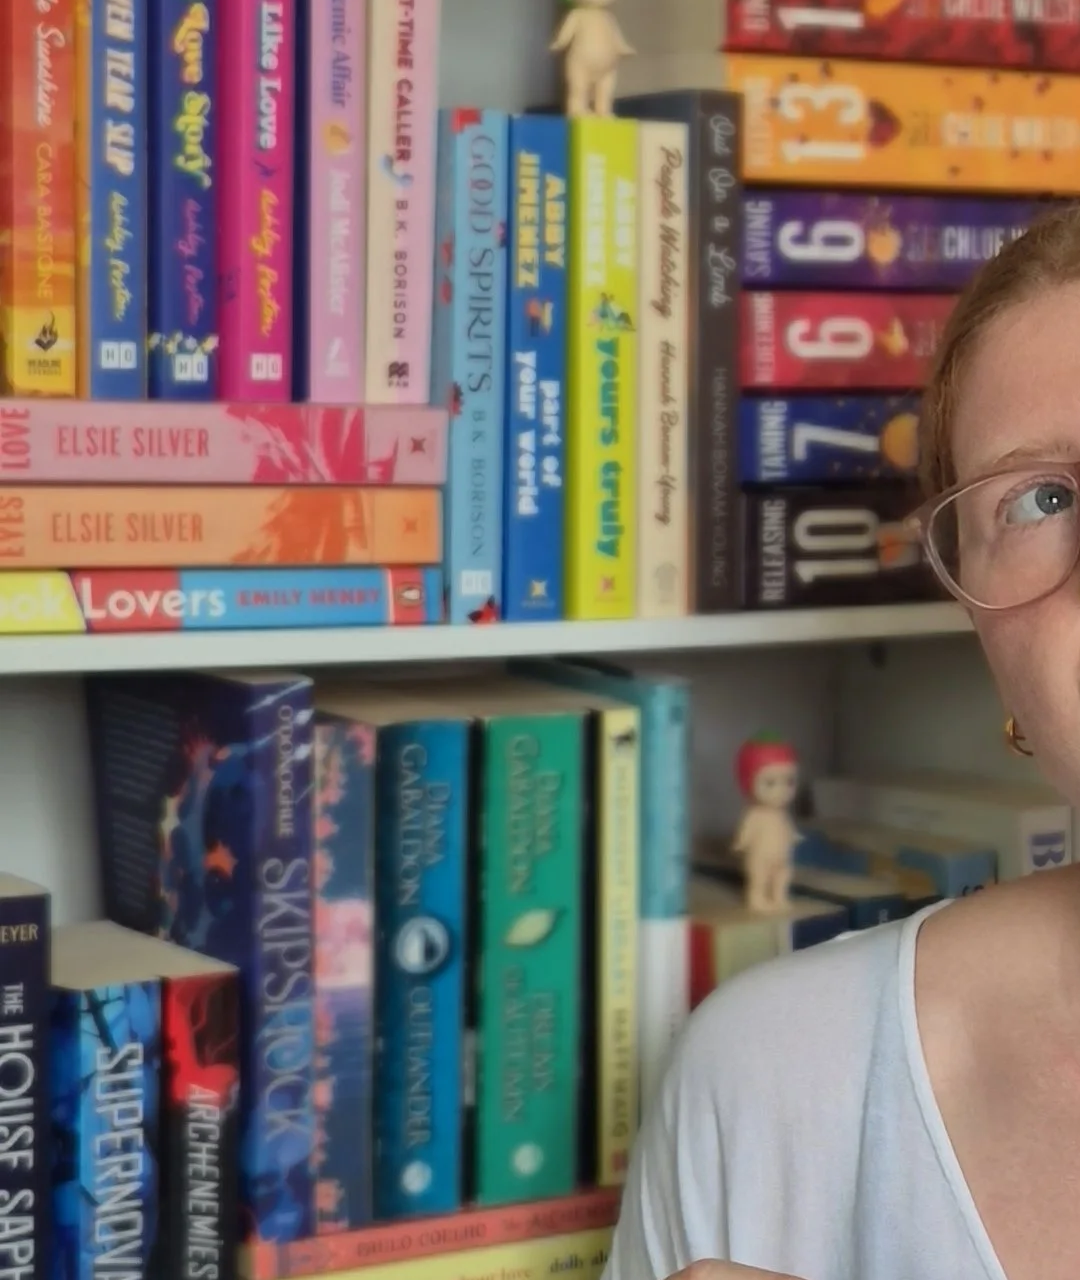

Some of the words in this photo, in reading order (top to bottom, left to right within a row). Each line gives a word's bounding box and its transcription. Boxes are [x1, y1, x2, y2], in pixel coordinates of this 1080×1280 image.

[173, 1, 211, 84] Love
[259, 0, 285, 71] Like
[36, 20, 67, 127] Sunshine
[104, 48, 136, 114] YEAR
[331, 49, 352, 108] Affair
[104, 117, 136, 176] SLIP
[176, 91, 212, 189] Story
[258, 76, 283, 150] Love
[396, 78, 414, 162] CALLER
[709, 113, 737, 157] Out
[777, 83, 867, 166] 13
[35, 141, 54, 199] CARA
[654, 146, 684, 220] People
[708, 167, 737, 203] On
[35, 204, 55, 301] BASTONE
[517, 150, 541, 288] JIMENEZ
[544, 172, 567, 269] ABBY
[712, 215, 731, 234] a
[744, 199, 774, 280] SAVING
[778, 221, 866, 263] 6
[393, 249, 408, 339] BORISON
[649, 224, 681, 320] Watching
[708, 242, 737, 308] Limb
[465, 247, 496, 394] SPIRITS
[786, 317, 874, 360] 6
[515, 350, 538, 420] your
[596, 336, 621, 447] yours
[659, 340, 678, 406] Hannah
[0, 407, 31, 470] LOVE
[57, 425, 121, 458] ELSIE
[131, 426, 210, 458] SILVER
[539, 380, 562, 446] part
[759, 401, 788, 482] TAMING
[792, 422, 881, 462] 7
[470, 458, 487, 557] BORISON
[517, 429, 540, 515] world
[542, 455, 563, 488] of
[0, 495, 26, 558] EYES
[50, 511, 115, 544] ELSIE
[125, 511, 204, 544] SILVER
[596, 461, 626, 559] truly
[794, 508, 881, 584] 10
[761, 499, 788, 601] RELEASING
[82, 578, 227, 620] Lovers
[237, 589, 302, 607] EMILY
[307, 587, 381, 606] HENRY
[400, 742, 428, 906] GABALDON
[426, 781, 452, 866] DIANA
[2, 981, 24, 1024] THE
[258, 857, 310, 1146] SKIPSHOCK
[0, 1023, 34, 1168] HOUSE
[407, 985, 433, 1150] OUTLANDER
[418, 1221, 489, 1248] COELHO
